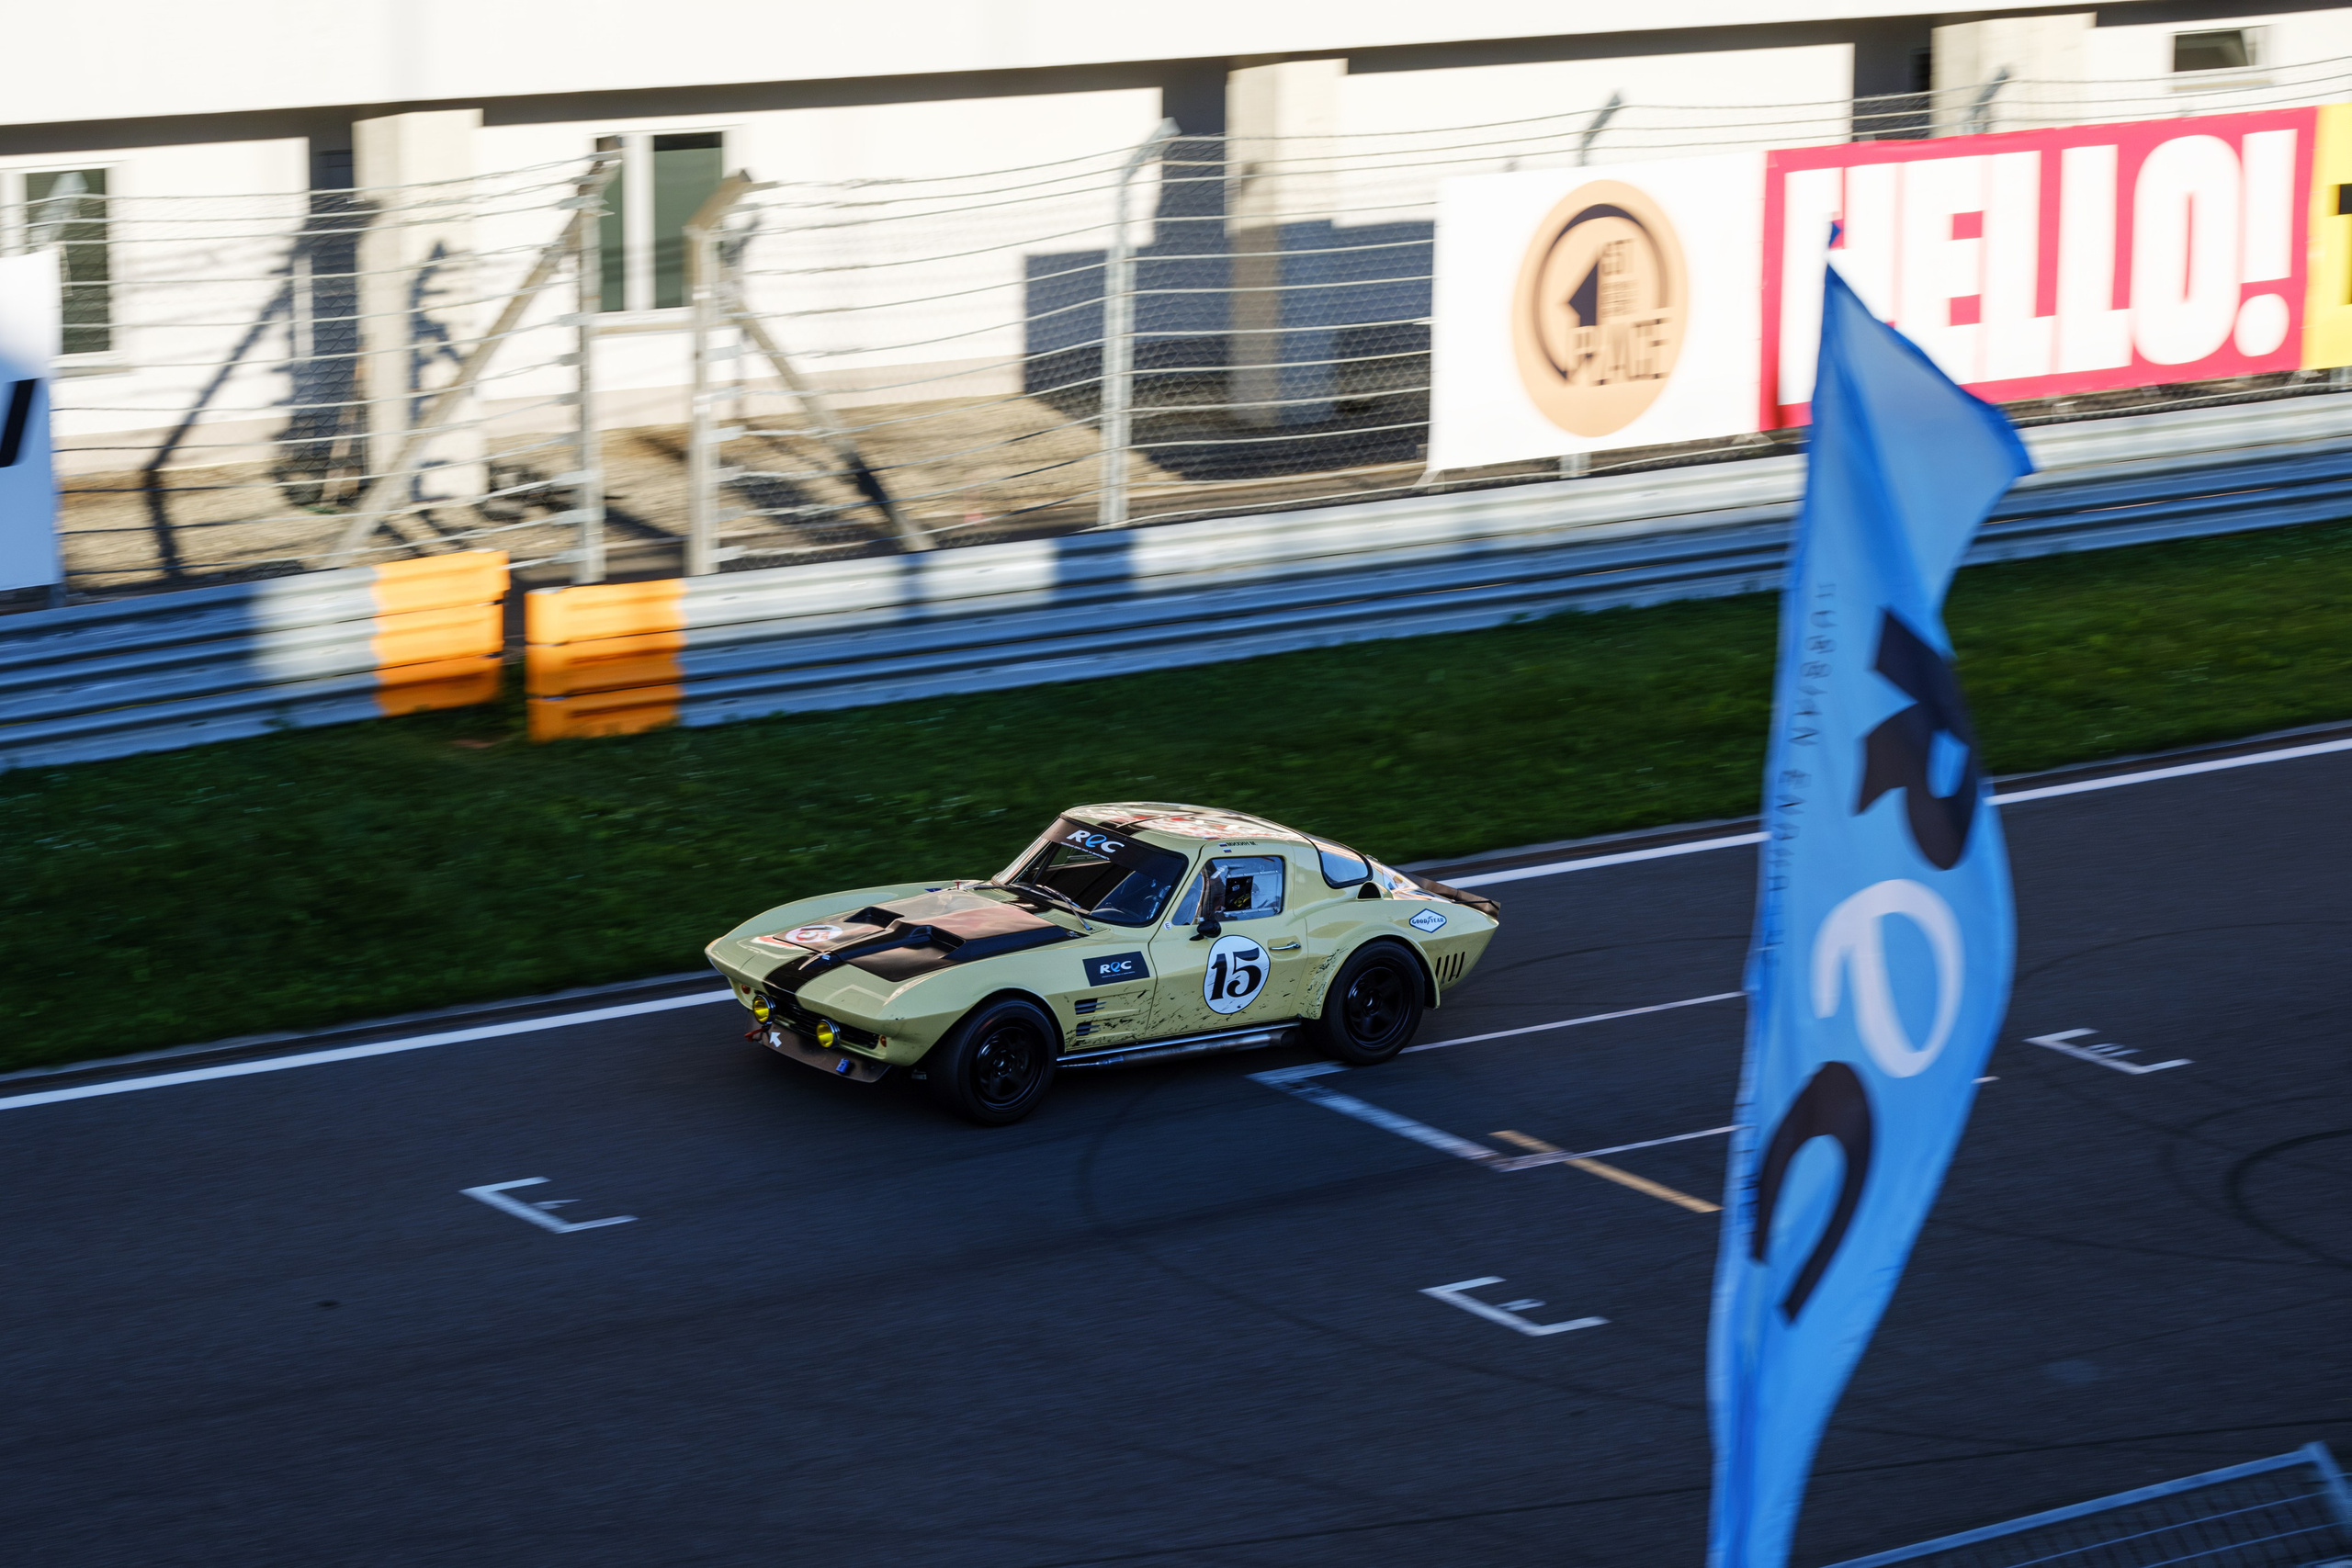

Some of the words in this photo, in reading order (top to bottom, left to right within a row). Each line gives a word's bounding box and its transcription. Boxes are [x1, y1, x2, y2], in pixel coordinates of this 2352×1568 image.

[1779, 128, 2298, 405] HELLO!
[797, 927, 831, 941] 15
[1209, 946, 1261, 1000] 15
